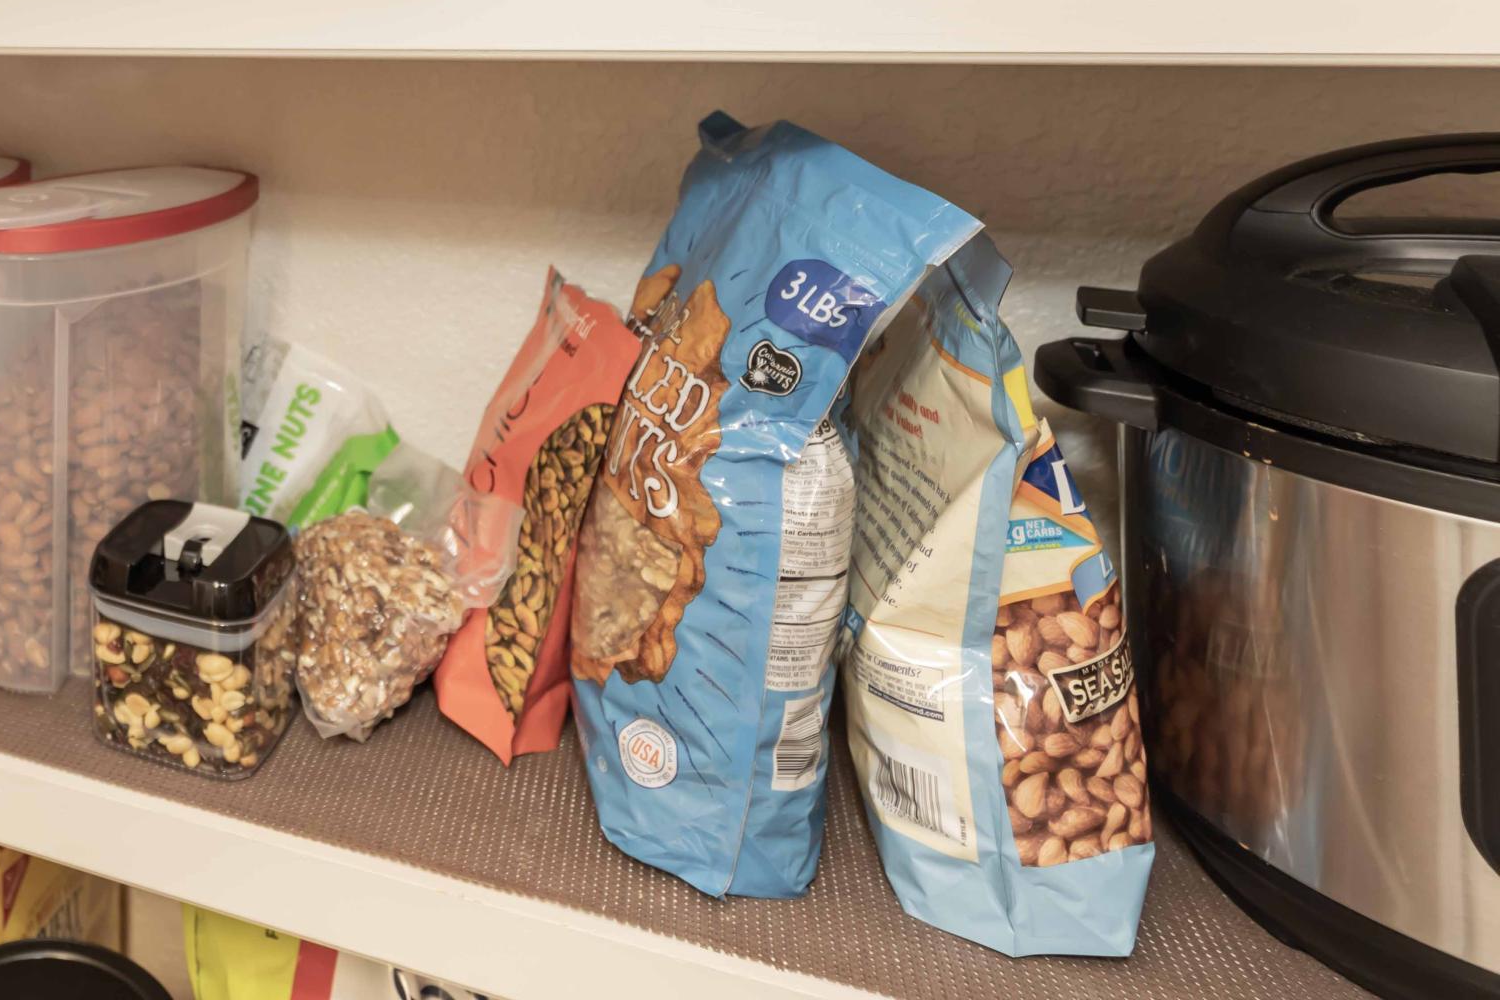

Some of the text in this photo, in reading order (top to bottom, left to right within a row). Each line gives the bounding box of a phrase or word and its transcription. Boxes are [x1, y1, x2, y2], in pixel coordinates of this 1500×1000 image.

[781, 272, 848, 327] 3 LBS
[243, 383, 322, 516] INE NUTS
[1025, 519, 1046, 529] NET
[1027, 527, 1062, 539] CARBS
[872, 655, 921, 678] Comments?
[1081, 658, 1110, 675] MADE
[1068, 670, 1113, 706] SEA
[632, 737, 659, 768] USA
